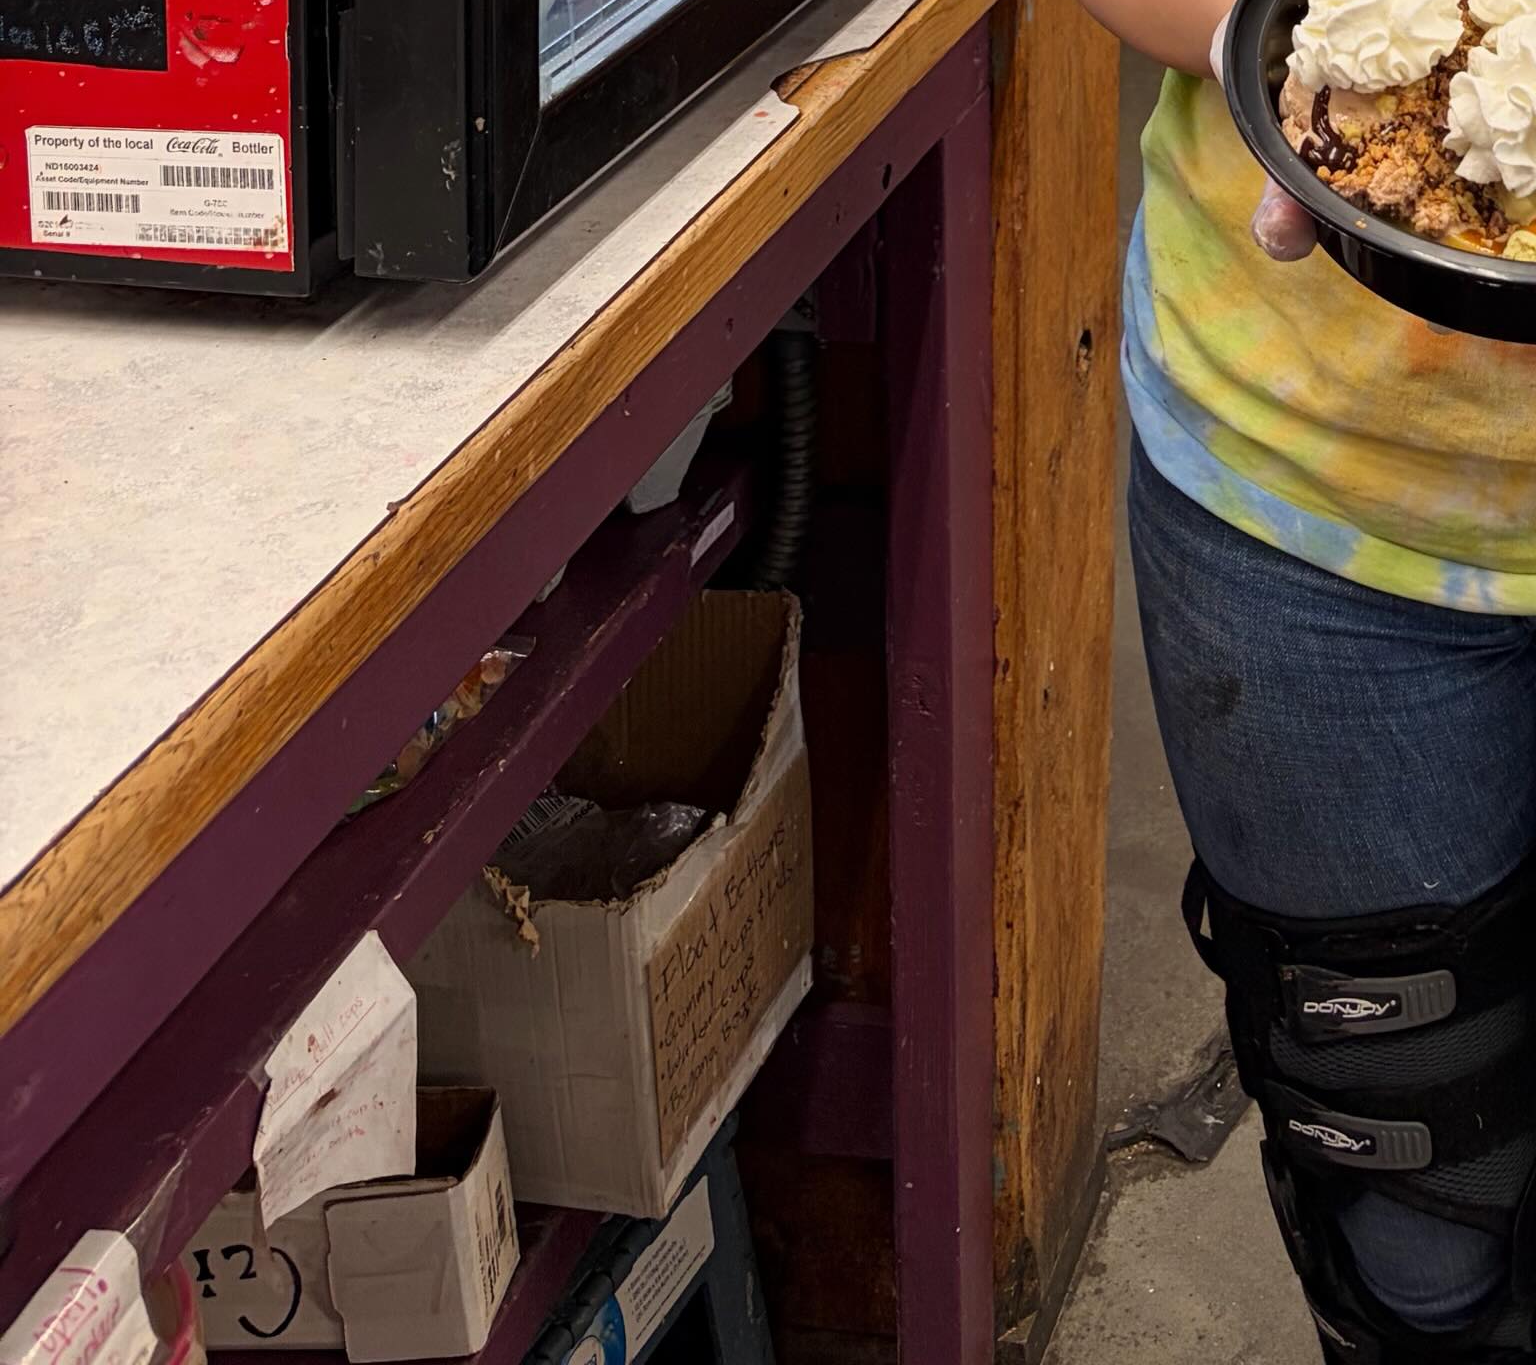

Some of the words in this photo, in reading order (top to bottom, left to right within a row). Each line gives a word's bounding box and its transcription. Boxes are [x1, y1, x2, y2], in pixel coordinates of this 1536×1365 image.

[34, 134, 84, 149] Property
[88, 136, 100, 148] of
[103, 137, 122, 149] the
[125, 137, 154, 150] local
[232, 141, 274, 155] Bottler
[120, 178, 149, 187] Number
[1303, 997, 1391, 1018] DONJOY
[1289, 1119, 1366, 1151] DONJOY
